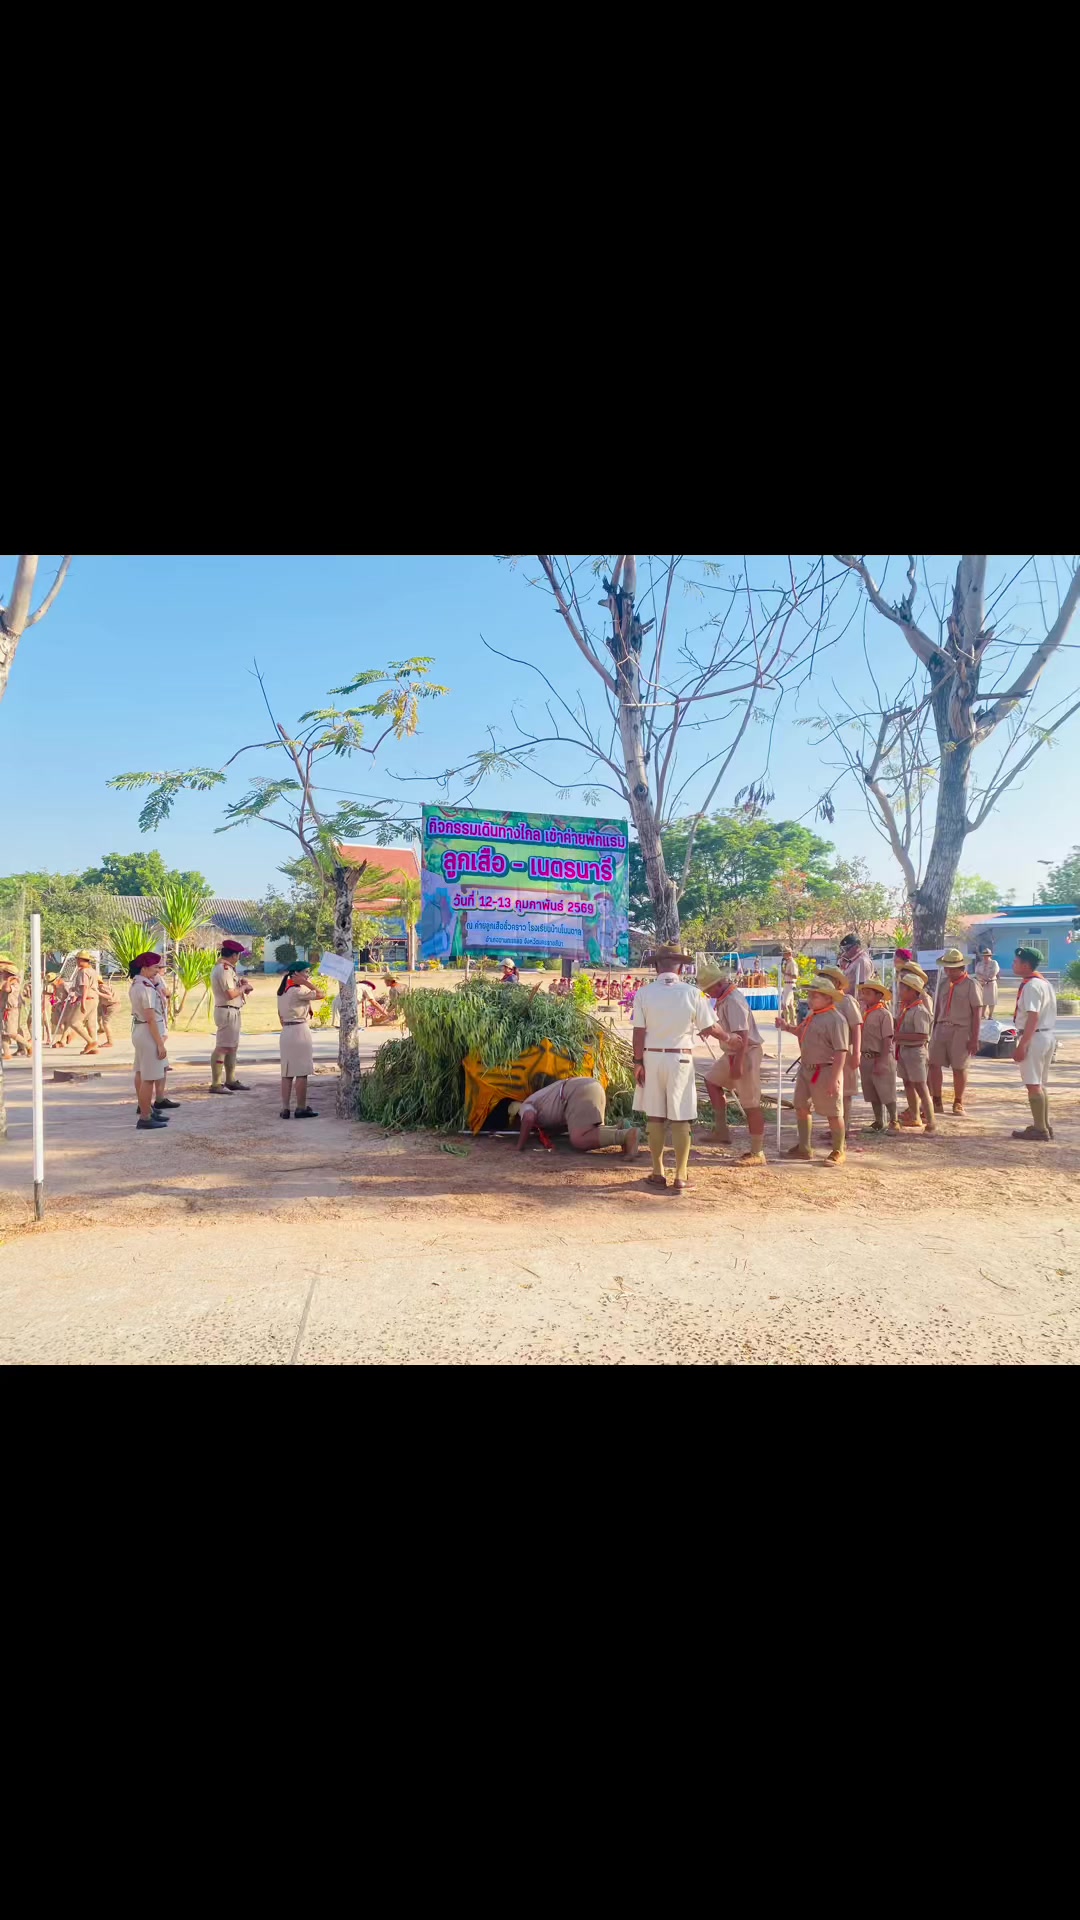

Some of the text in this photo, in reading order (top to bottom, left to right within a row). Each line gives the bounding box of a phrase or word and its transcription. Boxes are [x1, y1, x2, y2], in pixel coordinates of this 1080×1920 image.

[428, 818, 625, 848] กิจกรรมเดินทางไกล เข้าค่ายพักแรม
[443, 846, 506, 879] ลูกเสือ
[530, 854, 614, 881] เนตรนารี
[453, 890, 595, 914] วันที่ 12-13 กุมภาพันธ์ 2569
